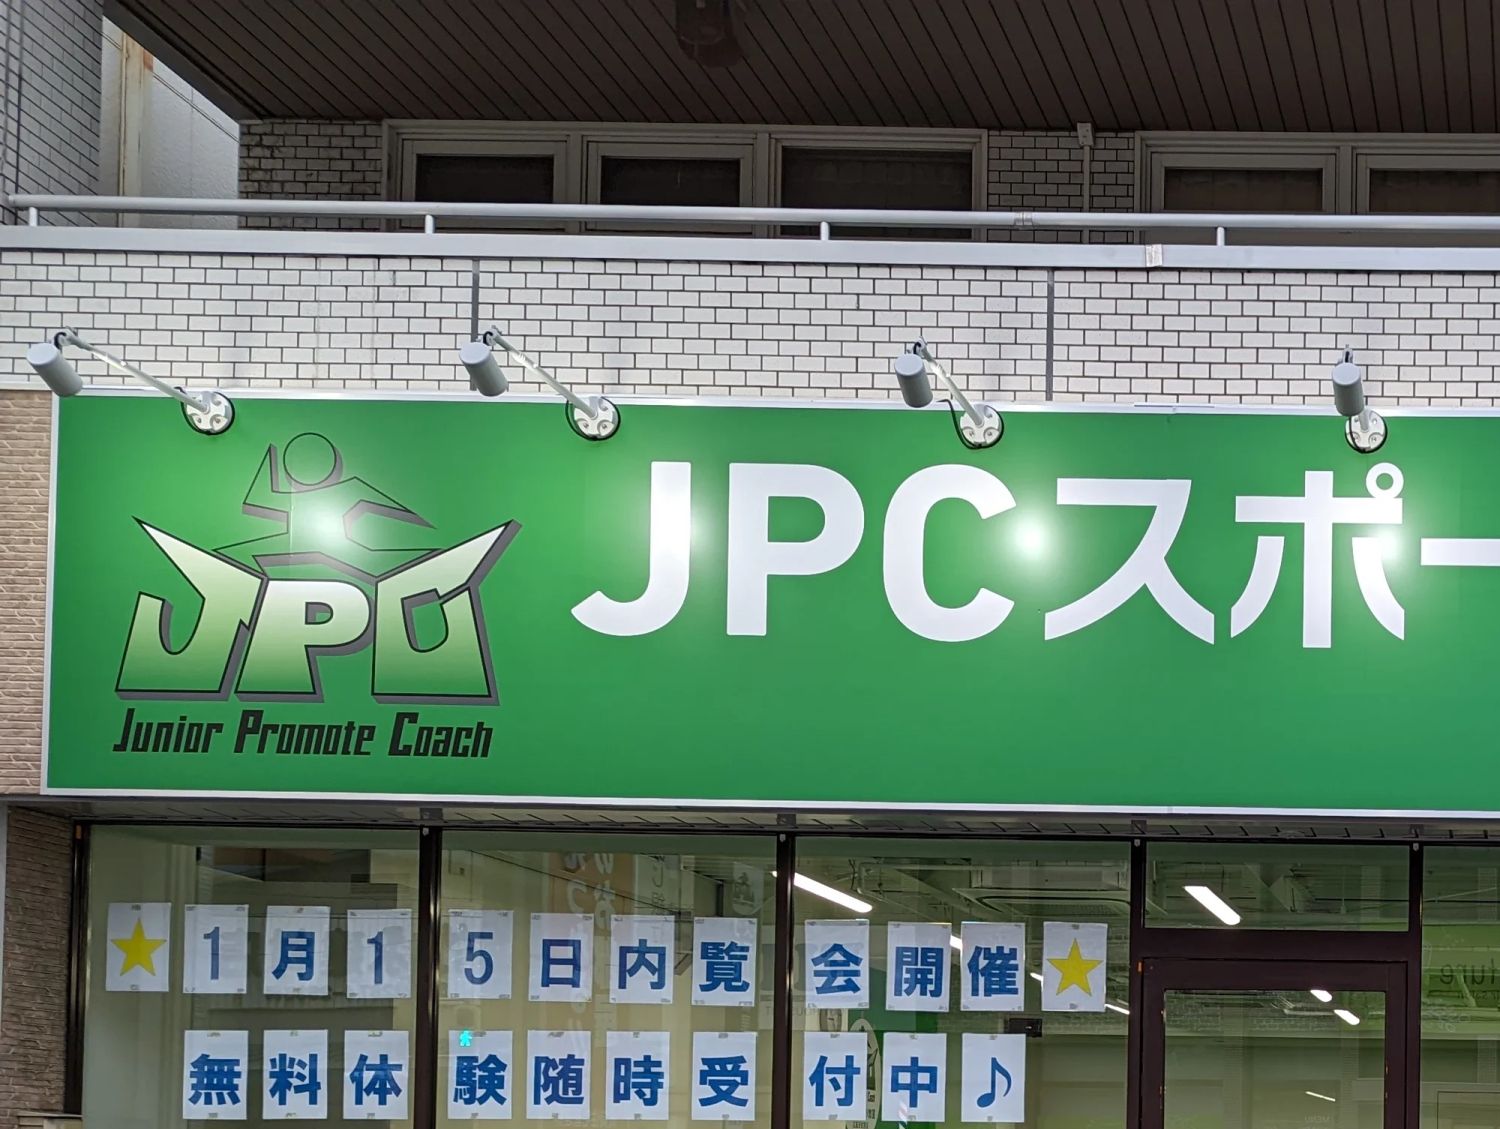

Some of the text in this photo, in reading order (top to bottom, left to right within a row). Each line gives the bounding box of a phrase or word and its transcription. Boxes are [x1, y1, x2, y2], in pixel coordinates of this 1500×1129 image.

[112, 707, 494, 758] Junior Promote Coach
